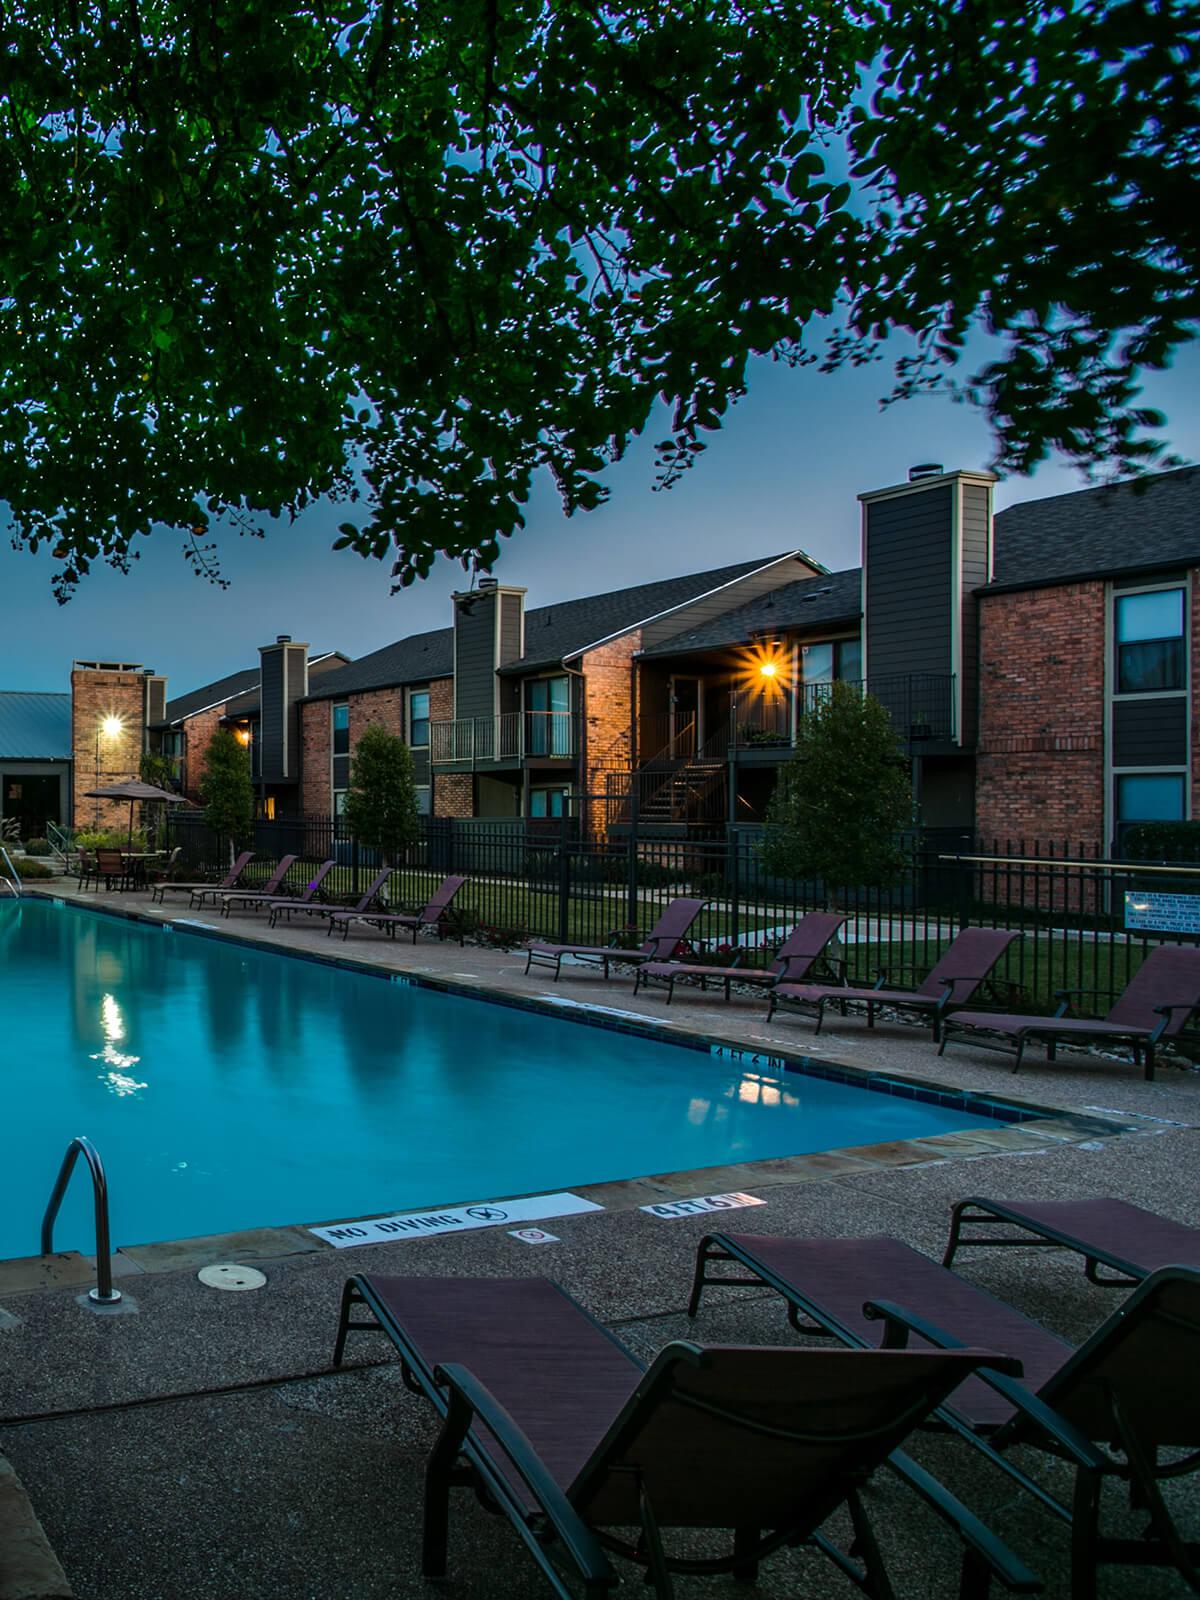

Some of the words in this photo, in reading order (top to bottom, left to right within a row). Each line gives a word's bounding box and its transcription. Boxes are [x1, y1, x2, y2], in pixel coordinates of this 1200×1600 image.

[730, 1049, 744, 1060] FT
[768, 1056, 782, 1069] IN
[652, 1206, 680, 1216] 4
[673, 1200, 709, 1213] FT
[704, 1198, 732, 1208] 6
[720, 1195, 753, 1205] IN
[326, 1227, 369, 1240] NO
[375, 1215, 463, 1233] DIVING
